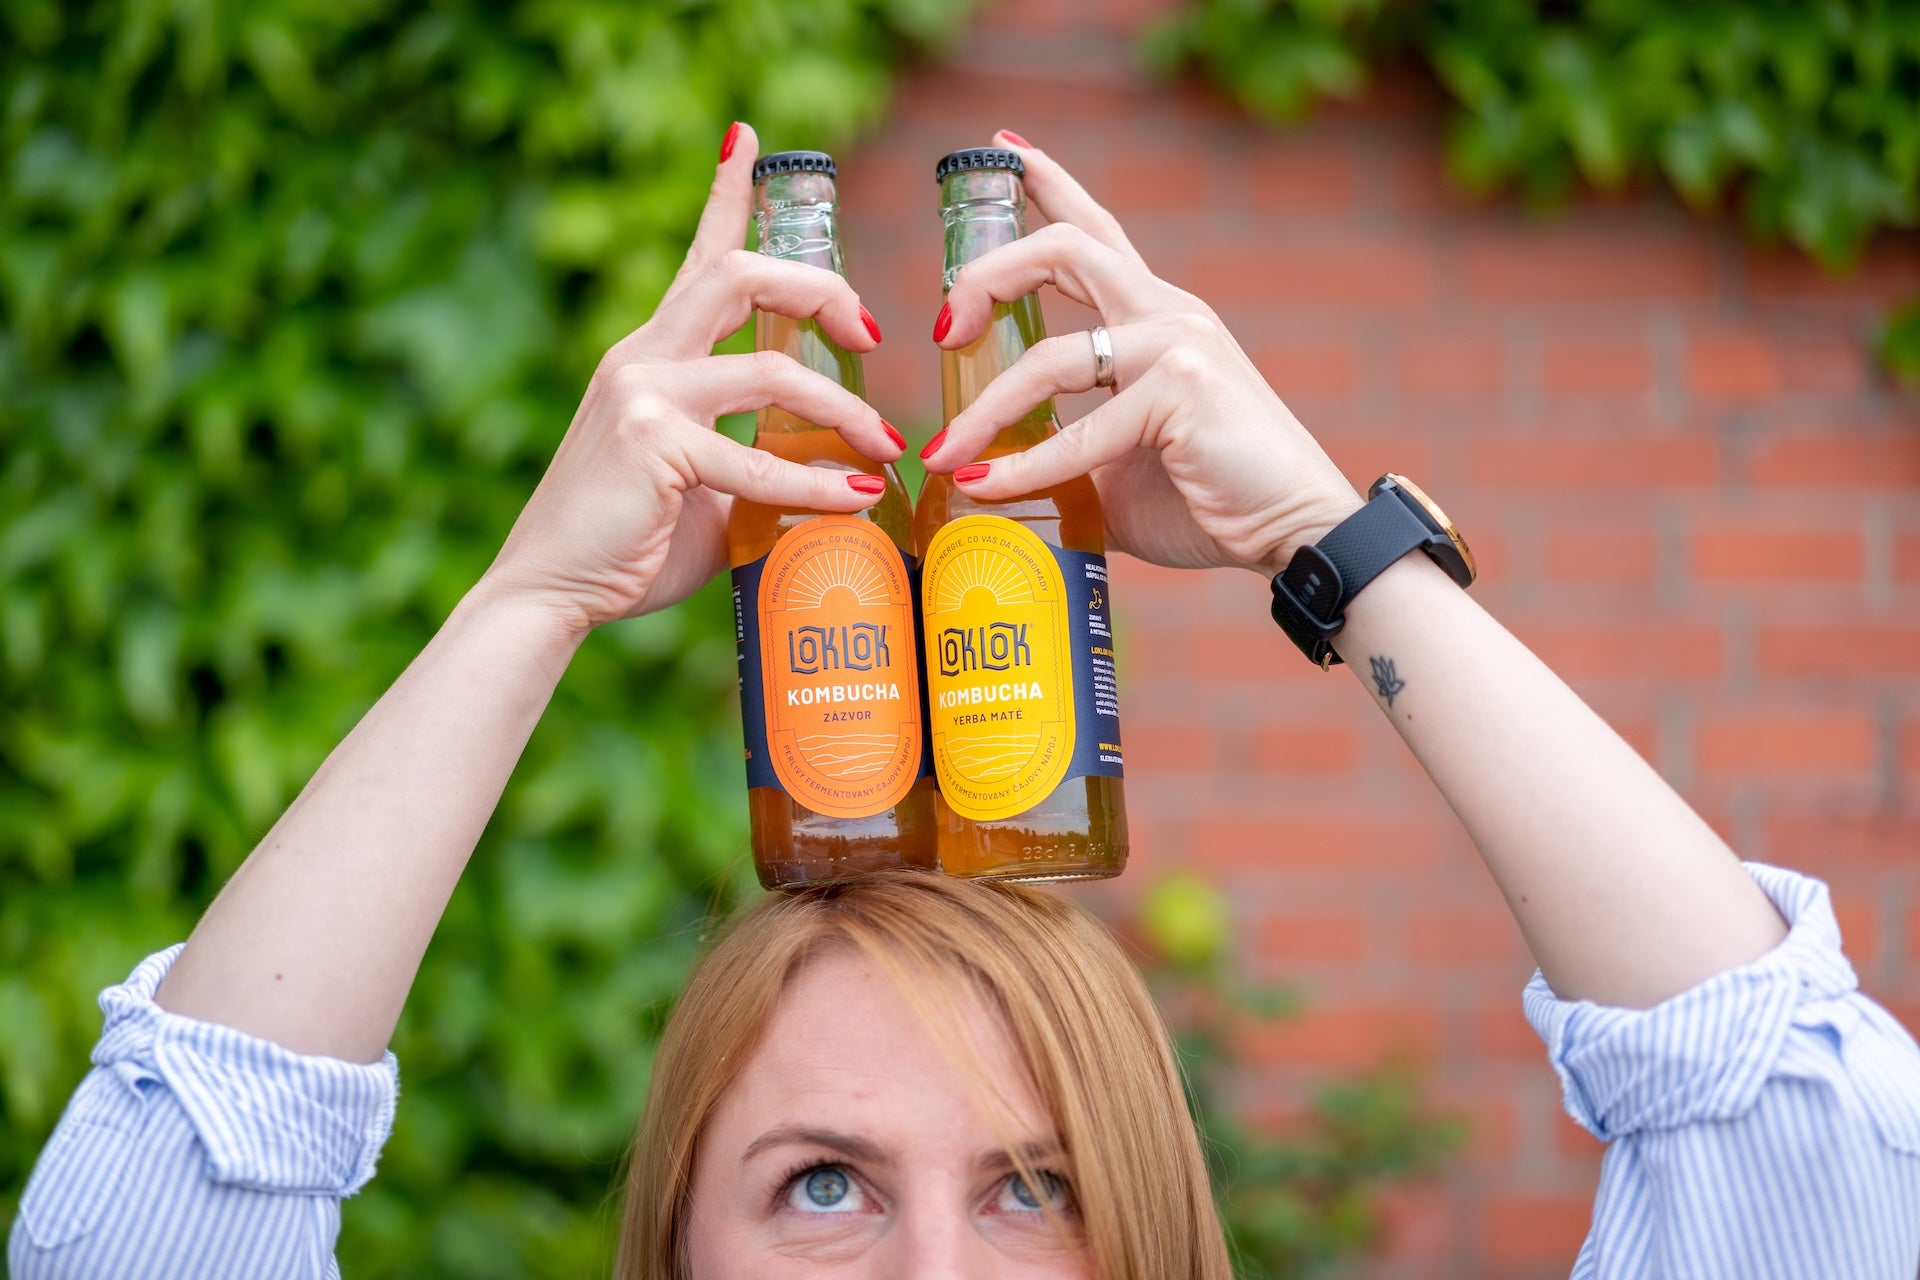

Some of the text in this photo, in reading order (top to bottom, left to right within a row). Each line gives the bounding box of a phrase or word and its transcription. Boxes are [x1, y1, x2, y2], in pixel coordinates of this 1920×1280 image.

[829, 535, 841, 543] CO
[967, 535, 979, 544] CO
[787, 683, 901, 707] KOMBUCHA
[938, 682, 1044, 709] KOMBUCHA
[823, 710, 872, 723] ZÁZVOR
[953, 708, 1024, 726] YERBA MATÉ
